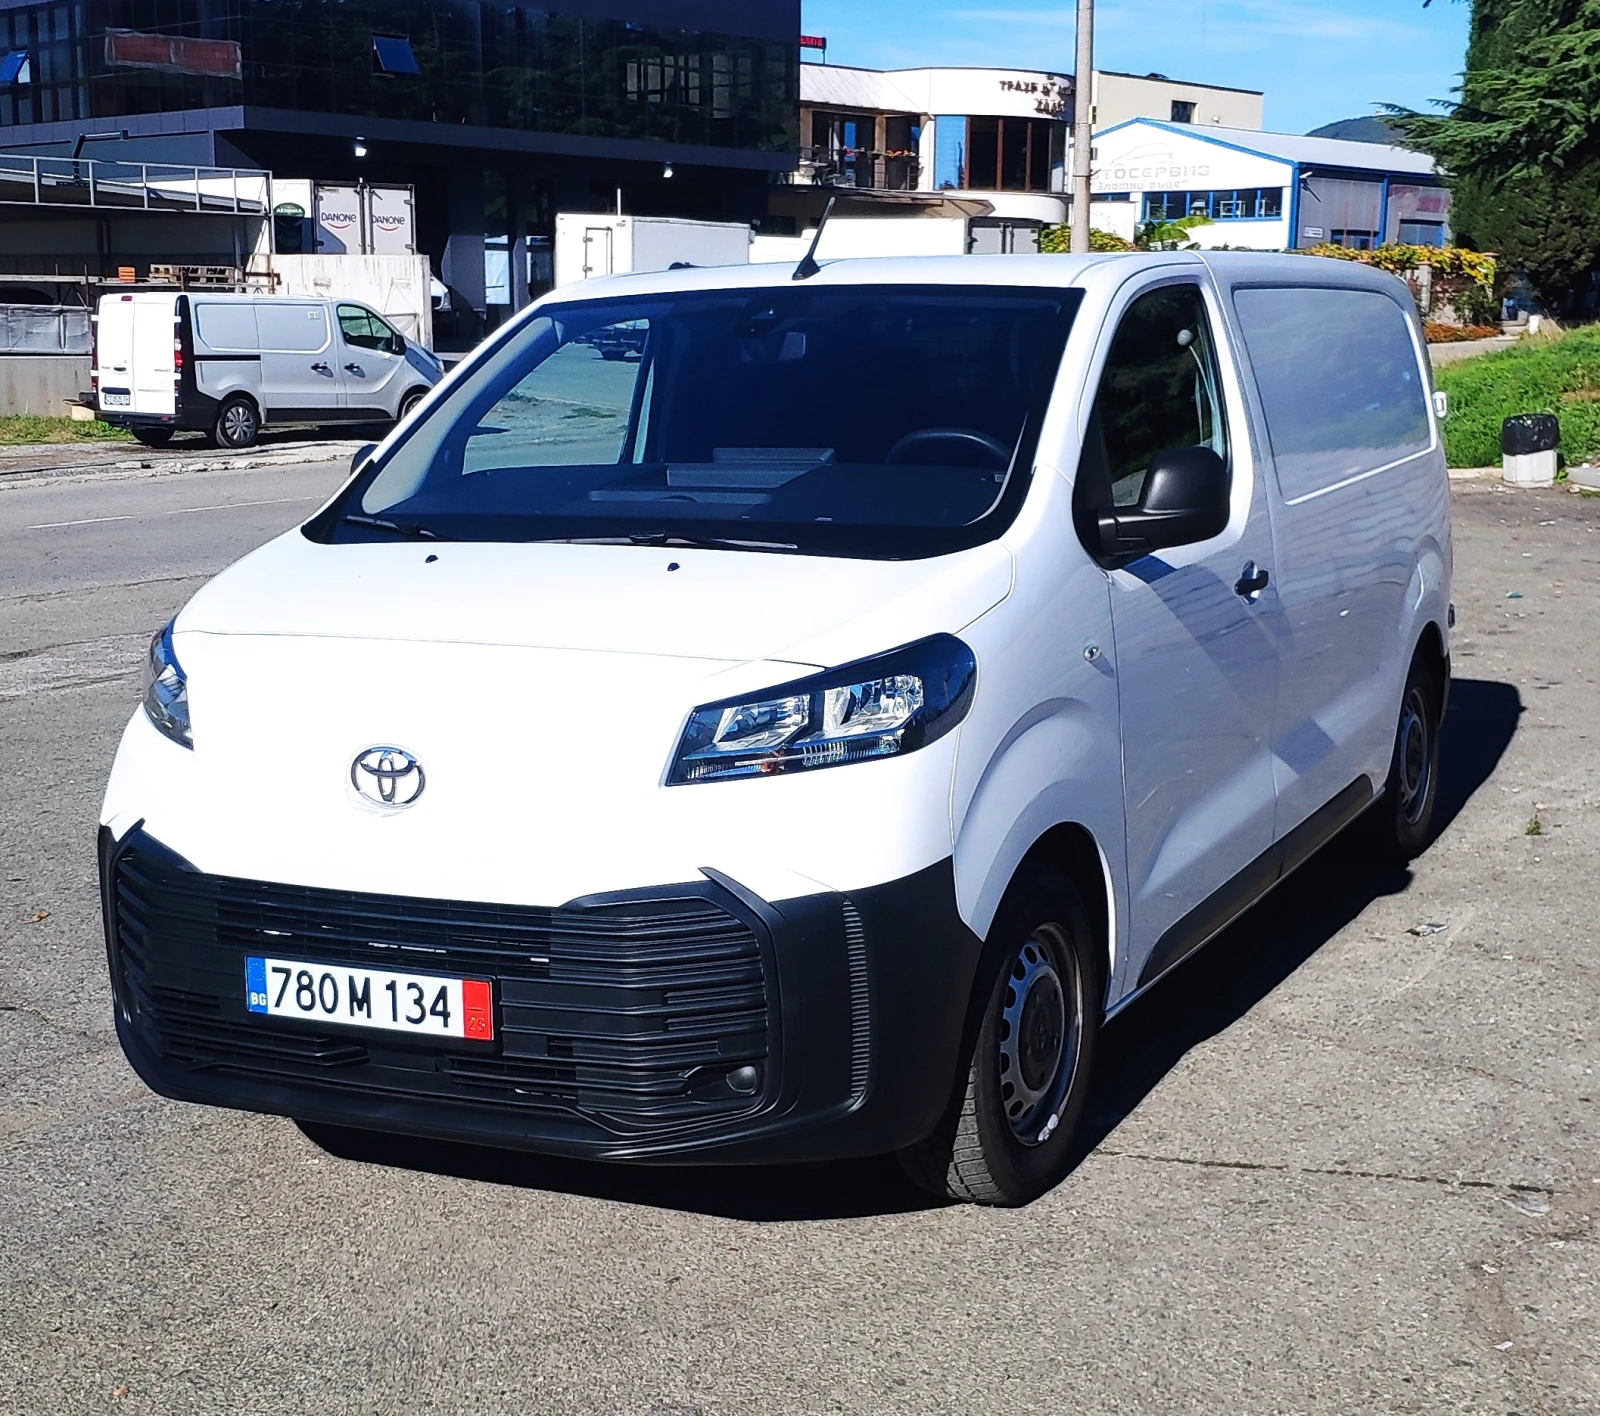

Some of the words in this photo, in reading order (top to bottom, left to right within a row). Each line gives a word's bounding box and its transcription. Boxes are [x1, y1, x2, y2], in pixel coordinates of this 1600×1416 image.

[1090, 165, 1210, 180] ТОСЕРВИЗ
[321, 212, 357, 223] DANONE
[371, 214, 405, 225] DANONE
[250, 991, 267, 1006] BG
[271, 966, 339, 1014] 780
[348, 975, 372, 1019] M
[385, 979, 451, 1028] 134
